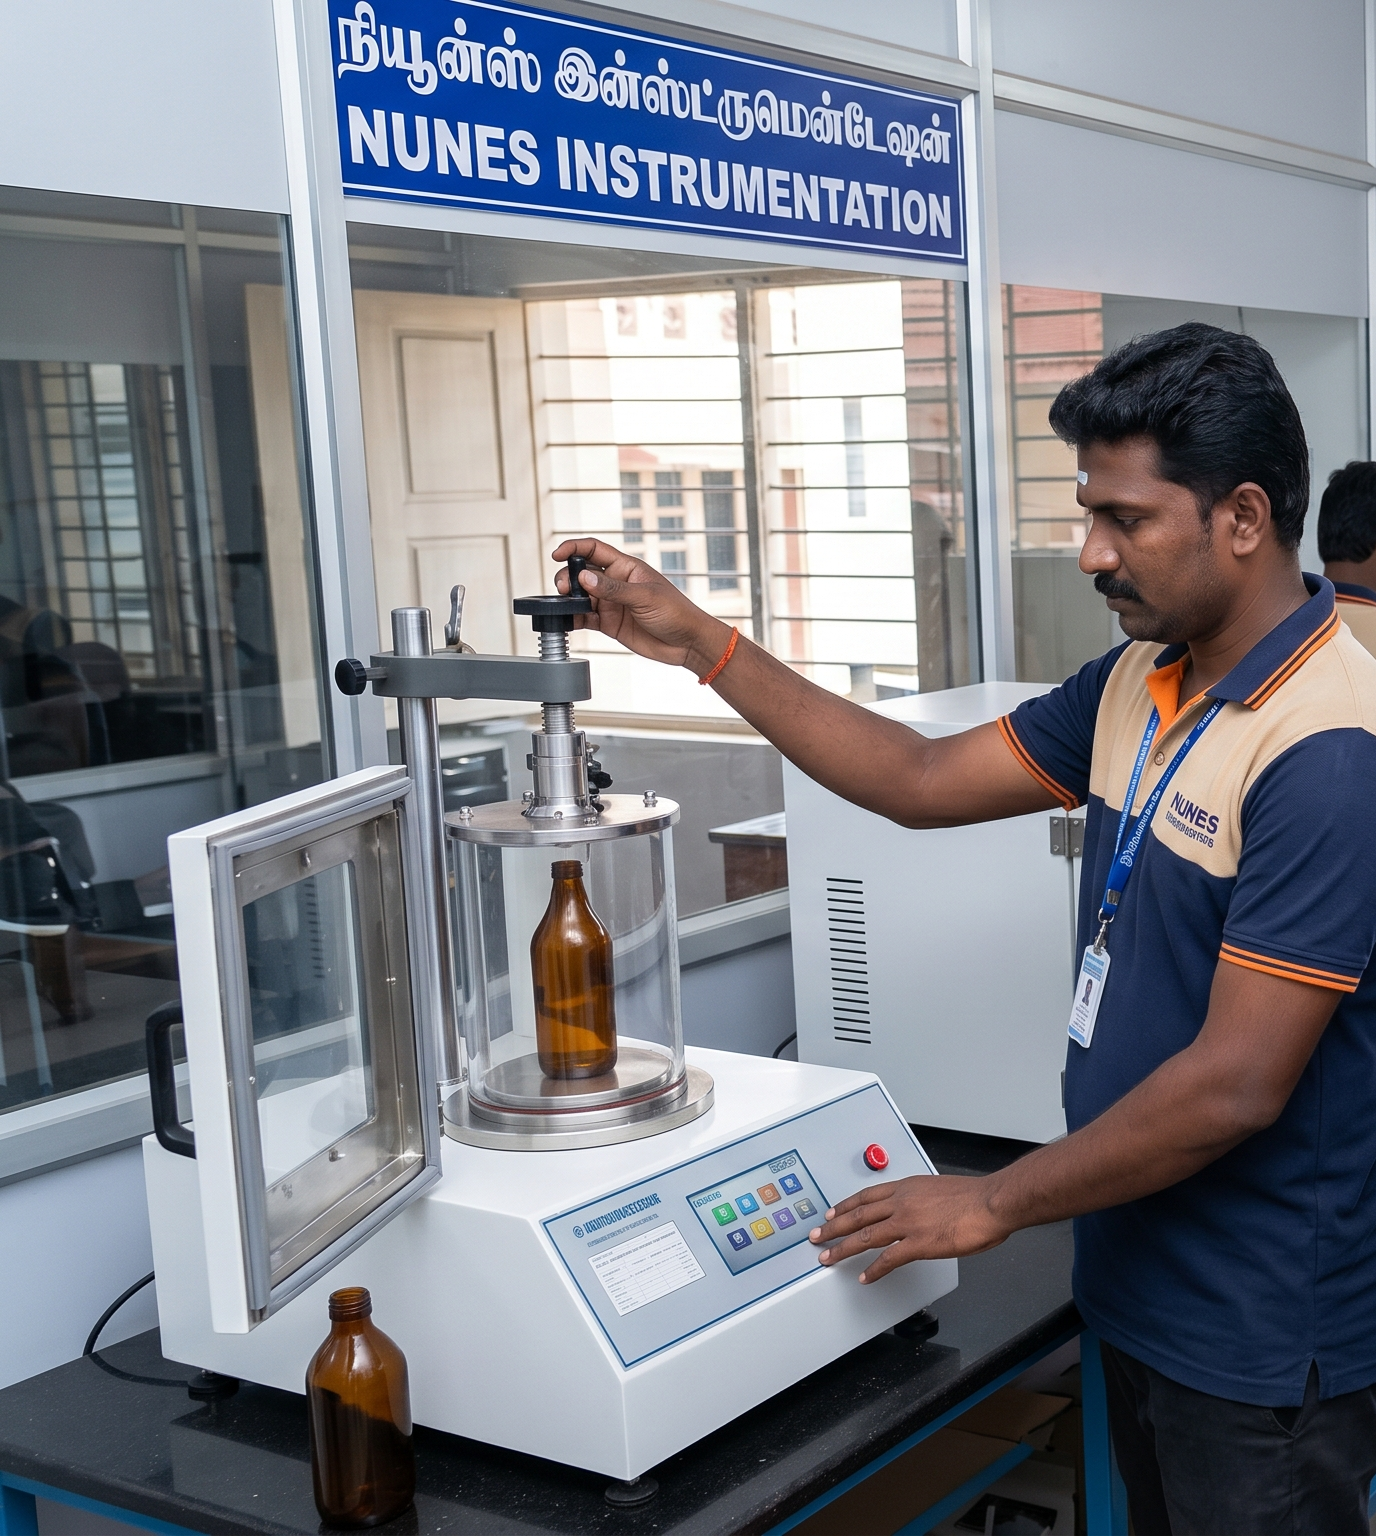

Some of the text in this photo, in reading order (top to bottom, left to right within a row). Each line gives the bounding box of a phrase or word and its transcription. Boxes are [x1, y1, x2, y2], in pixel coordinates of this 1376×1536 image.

[338, 1, 952, 168] நியூன்ஸ் இன்ஸ்ட்ருமென்டேஷன்
[347, 105, 952, 239] NUNES INSTRUMENTATION
[1170, 790, 1220, 835] NUNES
